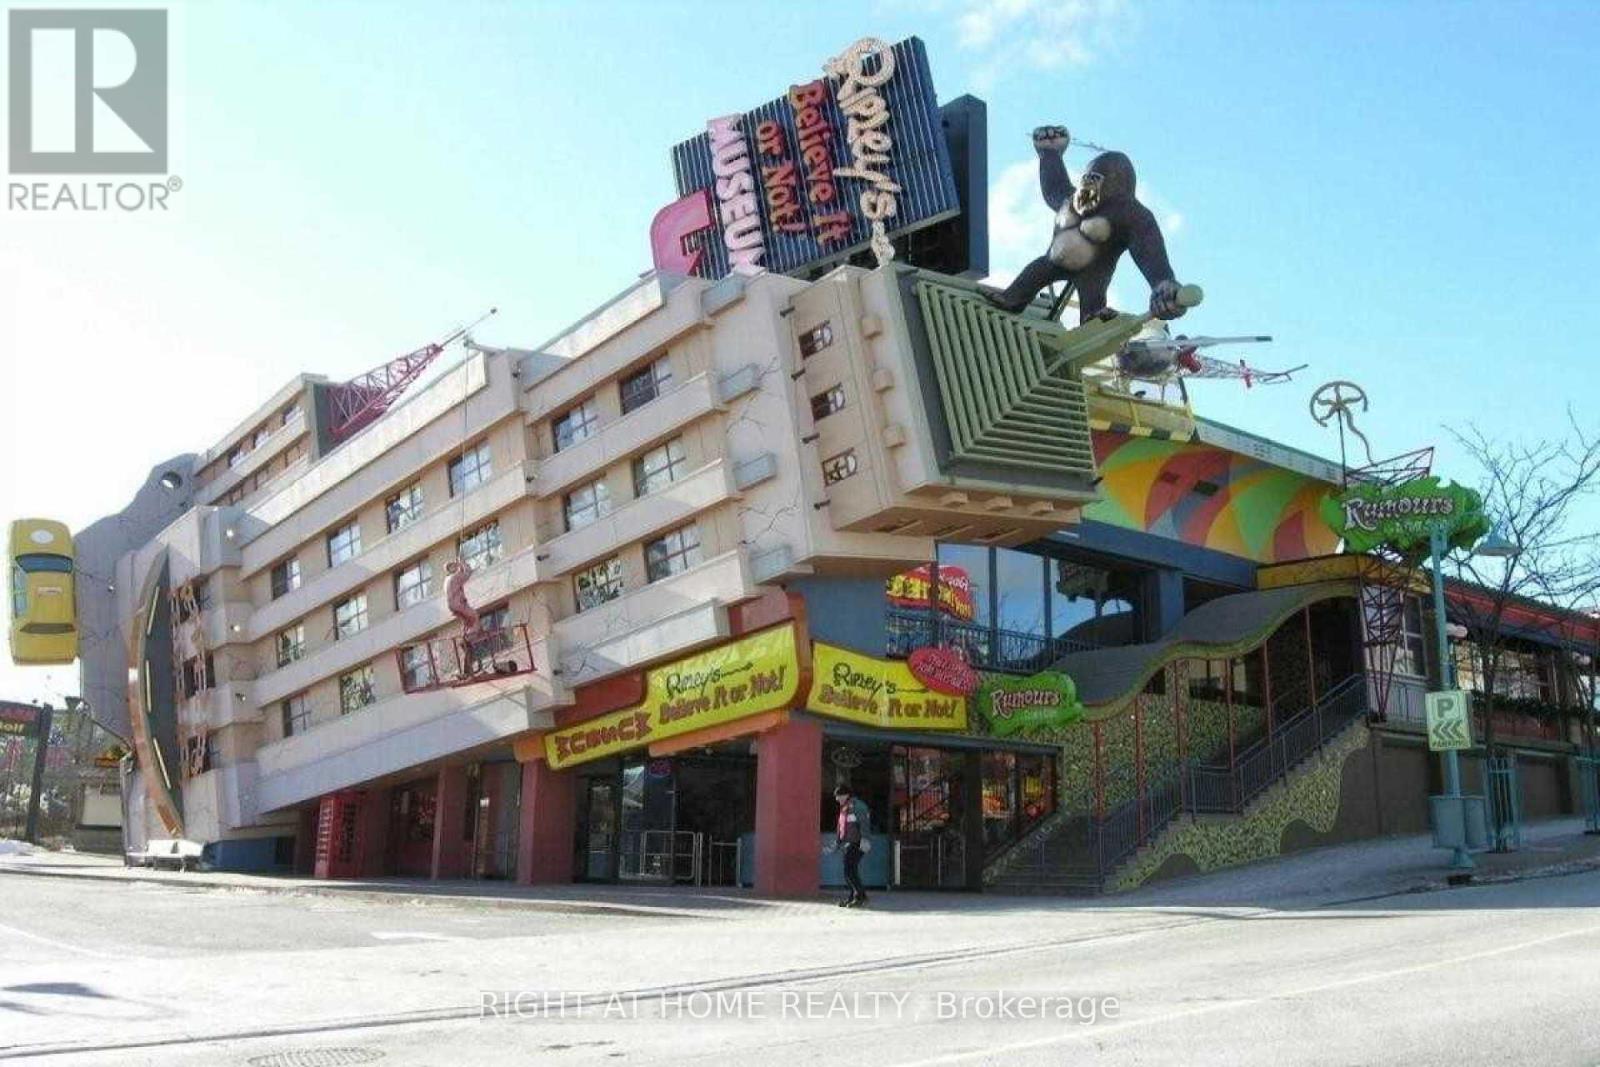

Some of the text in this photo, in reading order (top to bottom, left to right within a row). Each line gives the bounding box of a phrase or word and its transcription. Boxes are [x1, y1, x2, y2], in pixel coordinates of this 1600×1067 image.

[756, 120, 809, 234] or Not!
[789, 79, 855, 246] Believe It
[706, 113, 765, 275] MUSEUM
[1341, 497, 1453, 531] Rumours
[659, 694, 712, 725] Believe
[817, 683, 879, 715] Believe
[990, 689, 1063, 719] Rumours
[1436, 698, 1454, 719] P
